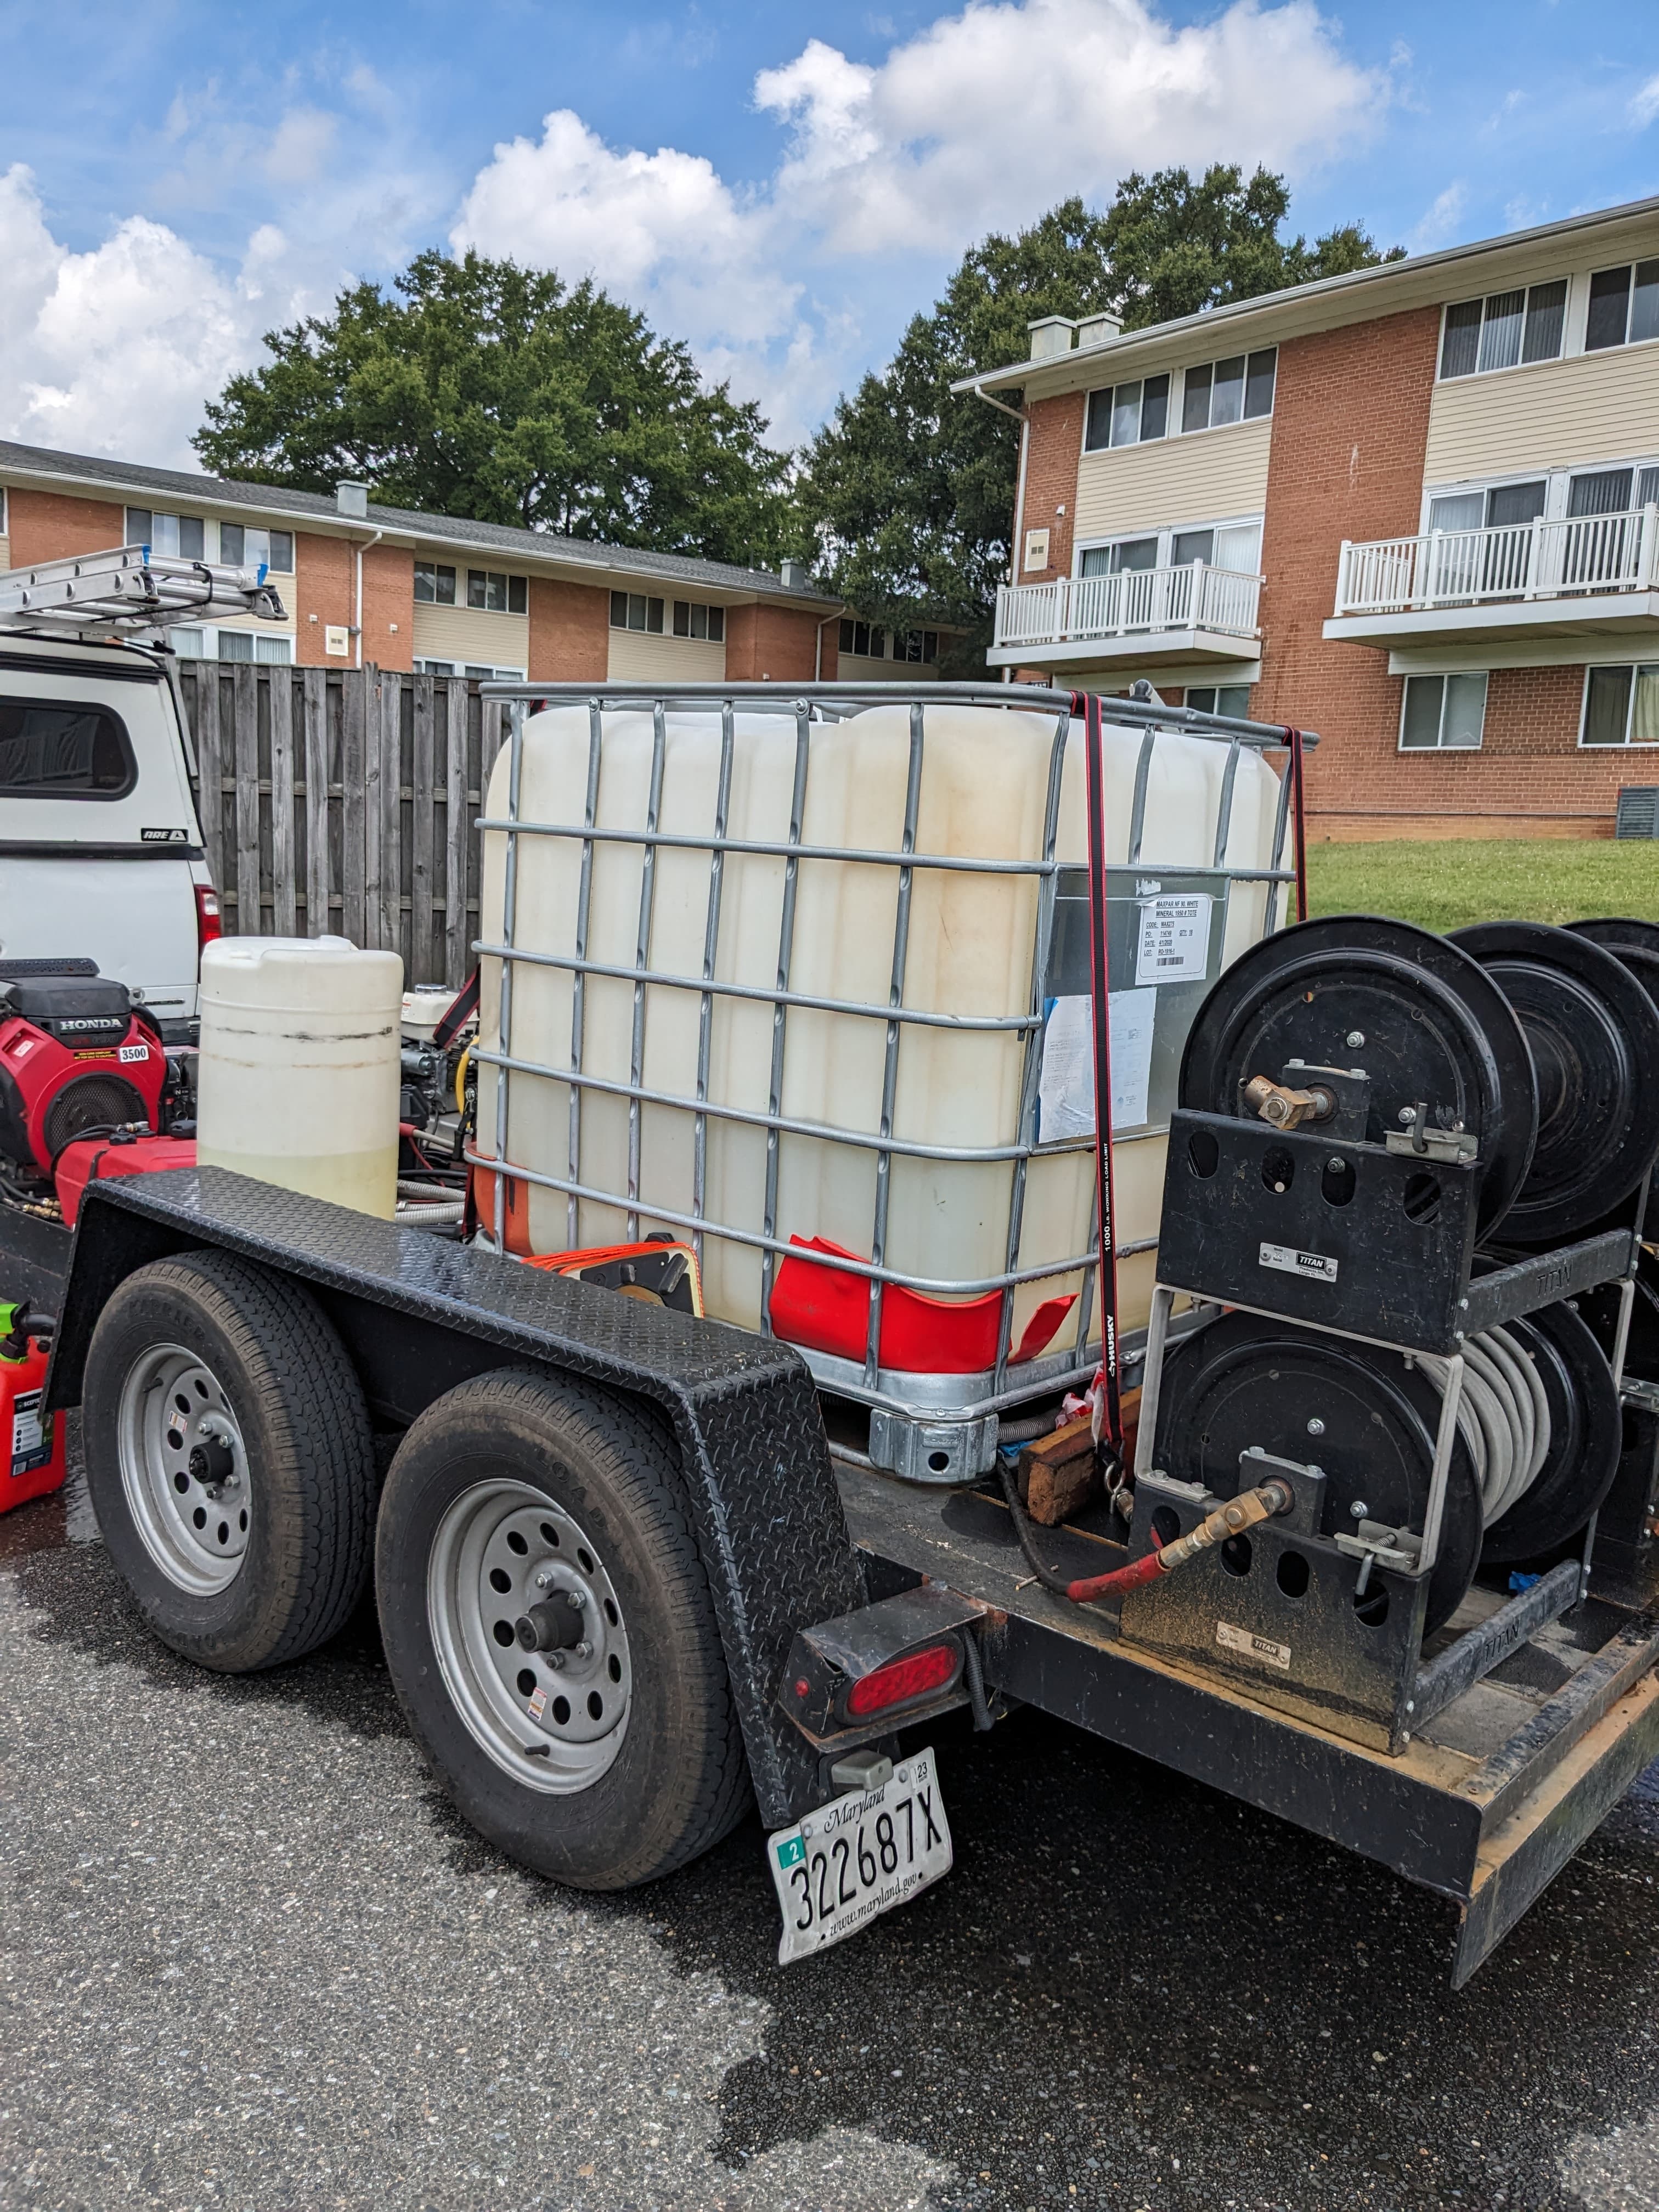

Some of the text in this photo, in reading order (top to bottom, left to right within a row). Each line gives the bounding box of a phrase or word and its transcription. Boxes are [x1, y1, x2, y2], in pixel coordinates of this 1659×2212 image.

[60, 1018, 123, 1031] HONDA
[122, 1048, 146, 1060] 3500
[1300, 1256, 1323, 1268] TITAN
[1538, 1264, 1572, 1296] TITAN
[1107, 1314, 1115, 1361] HUSKY
[536, 1447, 607, 1529] LOAD
[1254, 1639, 1277, 1654] TITAN
[1485, 1617, 1520, 1662] TITAN
[917, 1762, 927, 1779] 23
[824, 1787, 885, 1833] Maryland
[789, 1842, 799, 1861] 2
[791, 1785, 942, 1930] 322687X
[830, 1873, 917, 1937] www.maryland.gov
